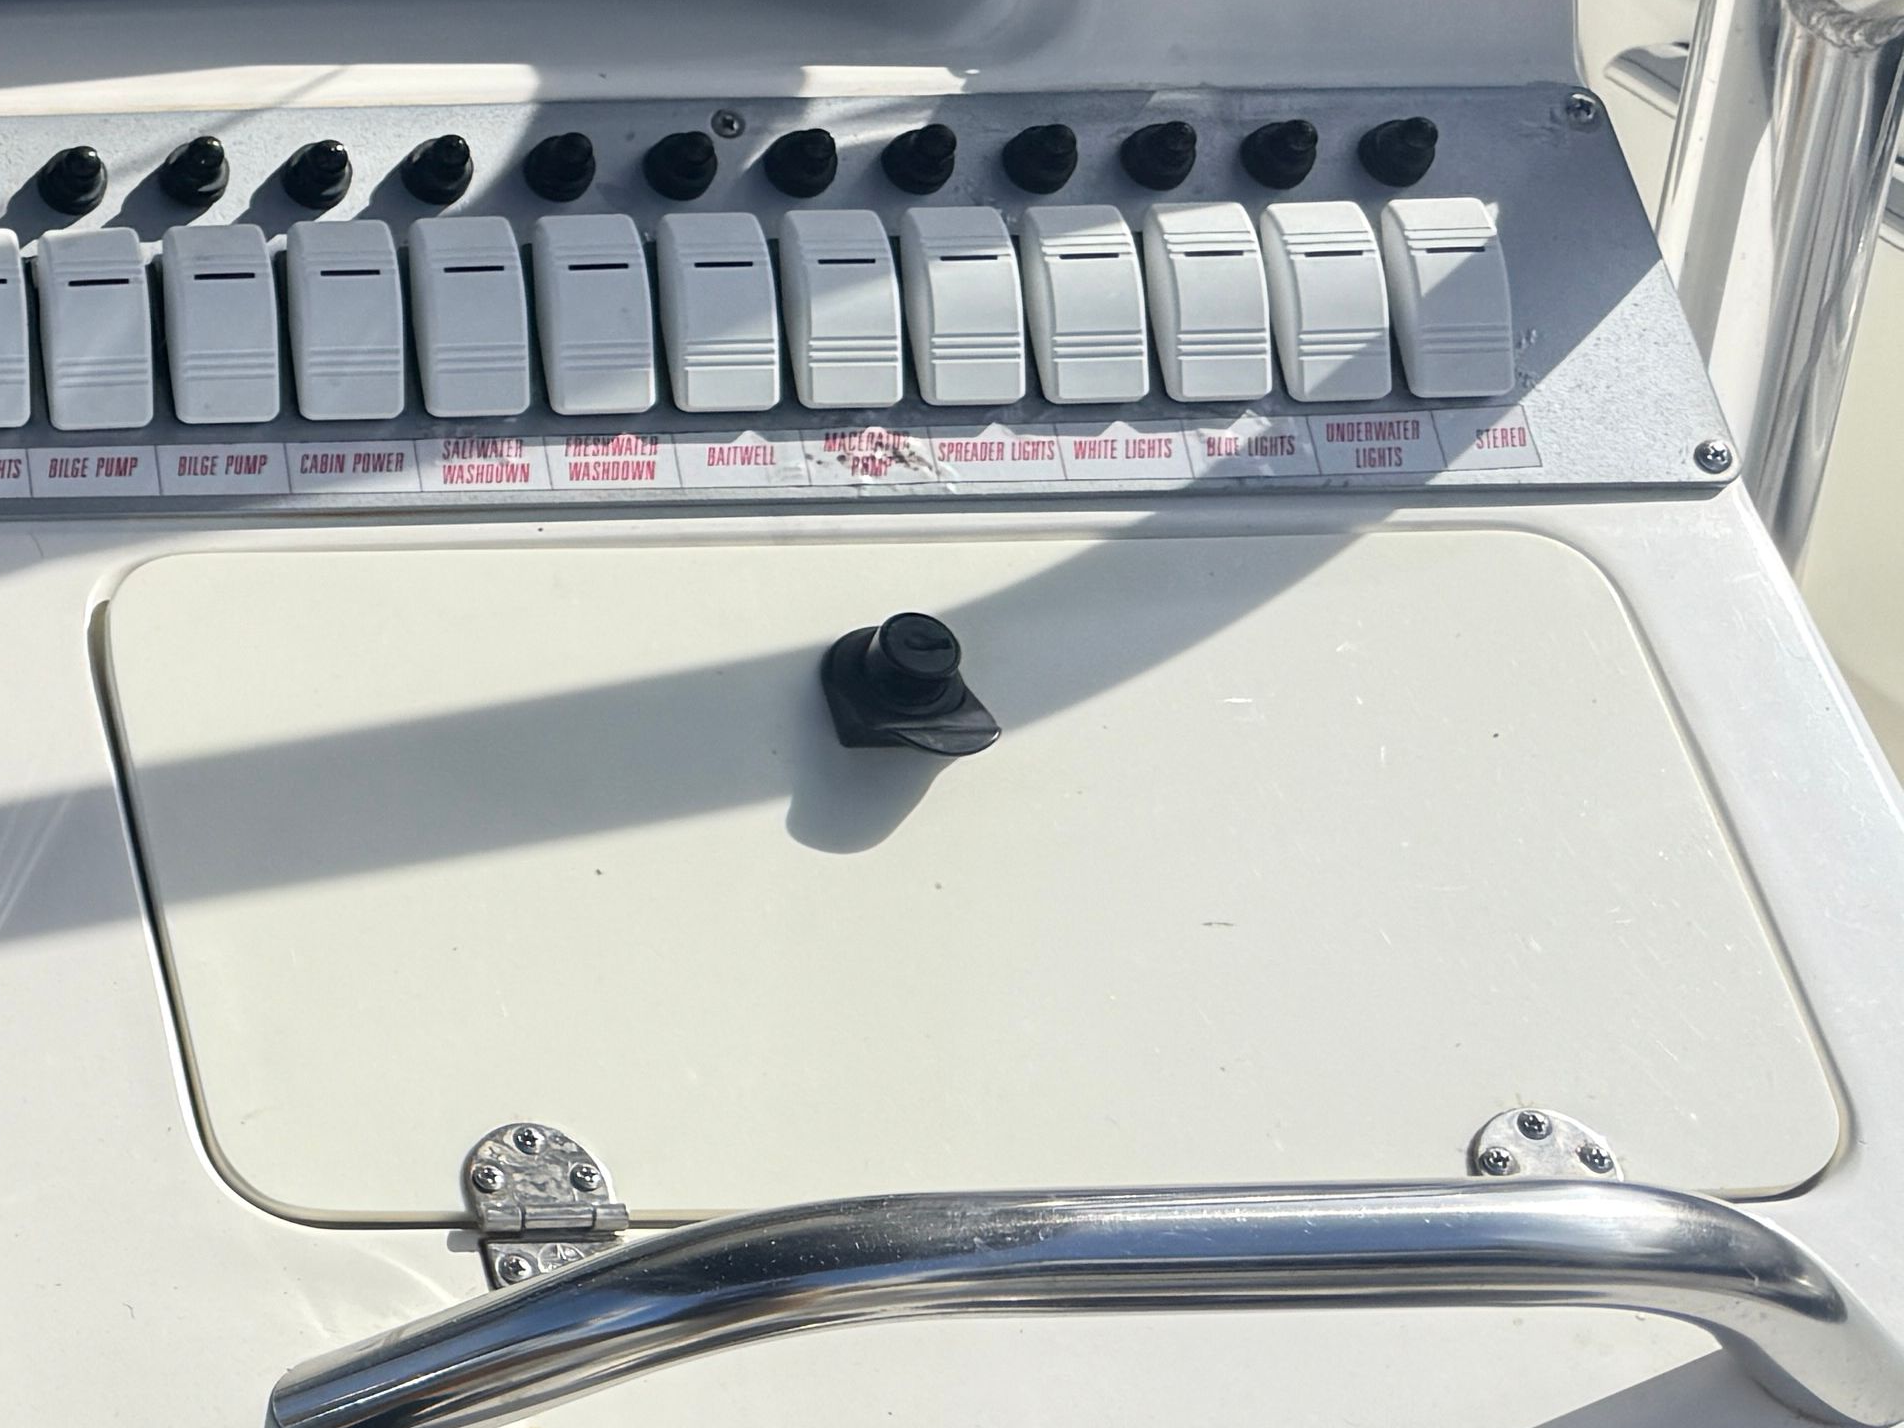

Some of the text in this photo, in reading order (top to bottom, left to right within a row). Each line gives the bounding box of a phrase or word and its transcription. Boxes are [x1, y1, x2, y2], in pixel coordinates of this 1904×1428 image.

[1325, 420, 1420, 442] UNDERWATER
[1475, 426, 1527, 450] STEREO
[443, 438, 524, 459] SALTWATER
[564, 435, 658, 457] FRESHWATER
[707, 446, 776, 466] BAITWELL
[939, 439, 1055, 461] SPREADER LIGHTS
[1073, 438, 1172, 460] WHITE LIGHTS
[1206, 435, 1296, 457] BLUE LIGHTS
[1355, 446, 1403, 468] LIGHTS
[48, 456, 139, 478] BILGE PUMP
[178, 454, 269, 477] BILGE PUMP
[300, 452, 405, 474] CABIN POWER
[443, 463, 530, 484] WASHDOWN
[568, 460, 656, 481] WASHDOWN
